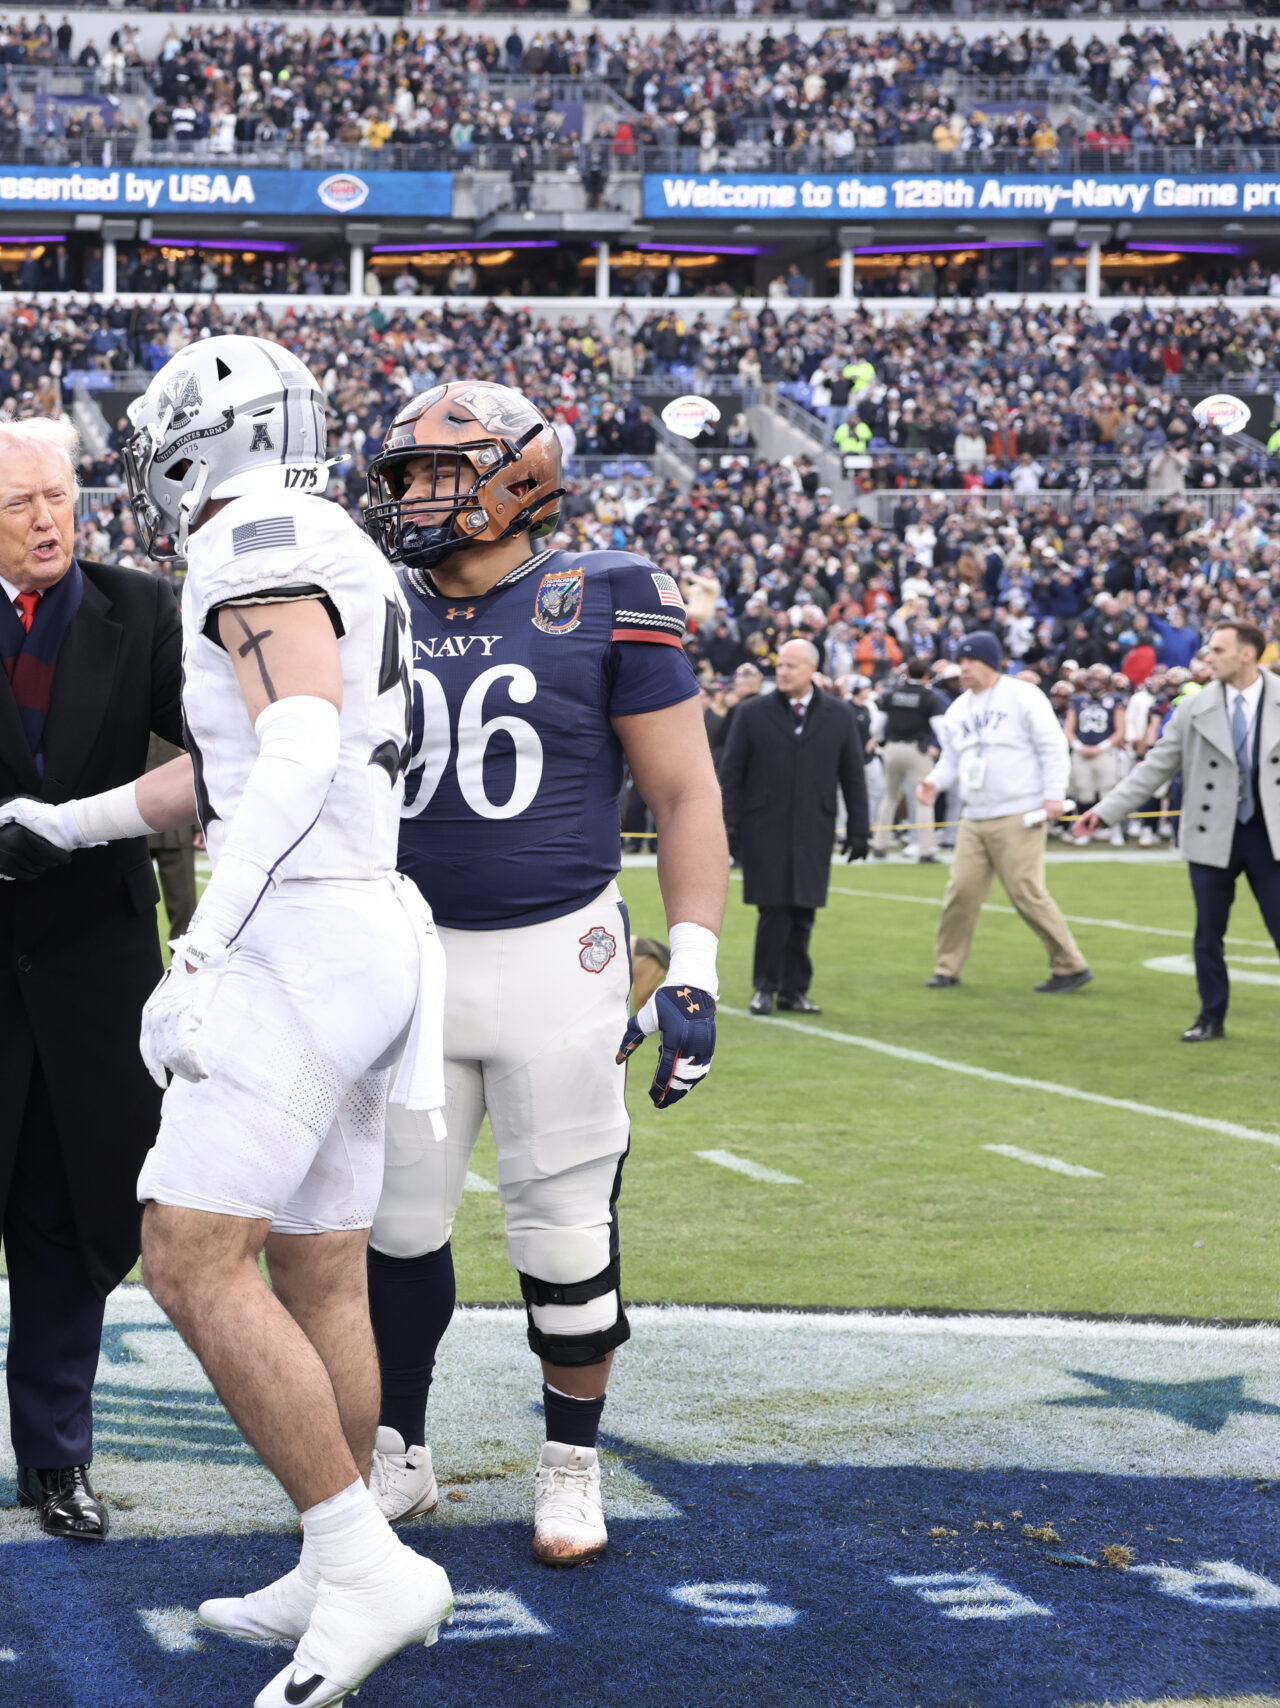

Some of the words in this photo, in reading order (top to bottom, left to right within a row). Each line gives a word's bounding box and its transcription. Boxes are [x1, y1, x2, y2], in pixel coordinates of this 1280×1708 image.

[126, 173, 164, 208] by
[169, 174, 255, 204] USAA
[662, 178, 796, 208] Welcome
[800, 181, 832, 208] to
[837, 178, 887, 208] the
[891, 179, 974, 208] 126th
[979, 179, 1150, 214] Army-Navy
[1154, 178, 1237, 208] Game
[156, 444, 176, 462] UNITED
[176, 431, 201, 448] STATES
[203, 423, 229, 437] ARMY
[182, 443, 199, 456] 1775
[284, 467, 318, 488] 1775
[413, 635, 503, 660] NAVY
